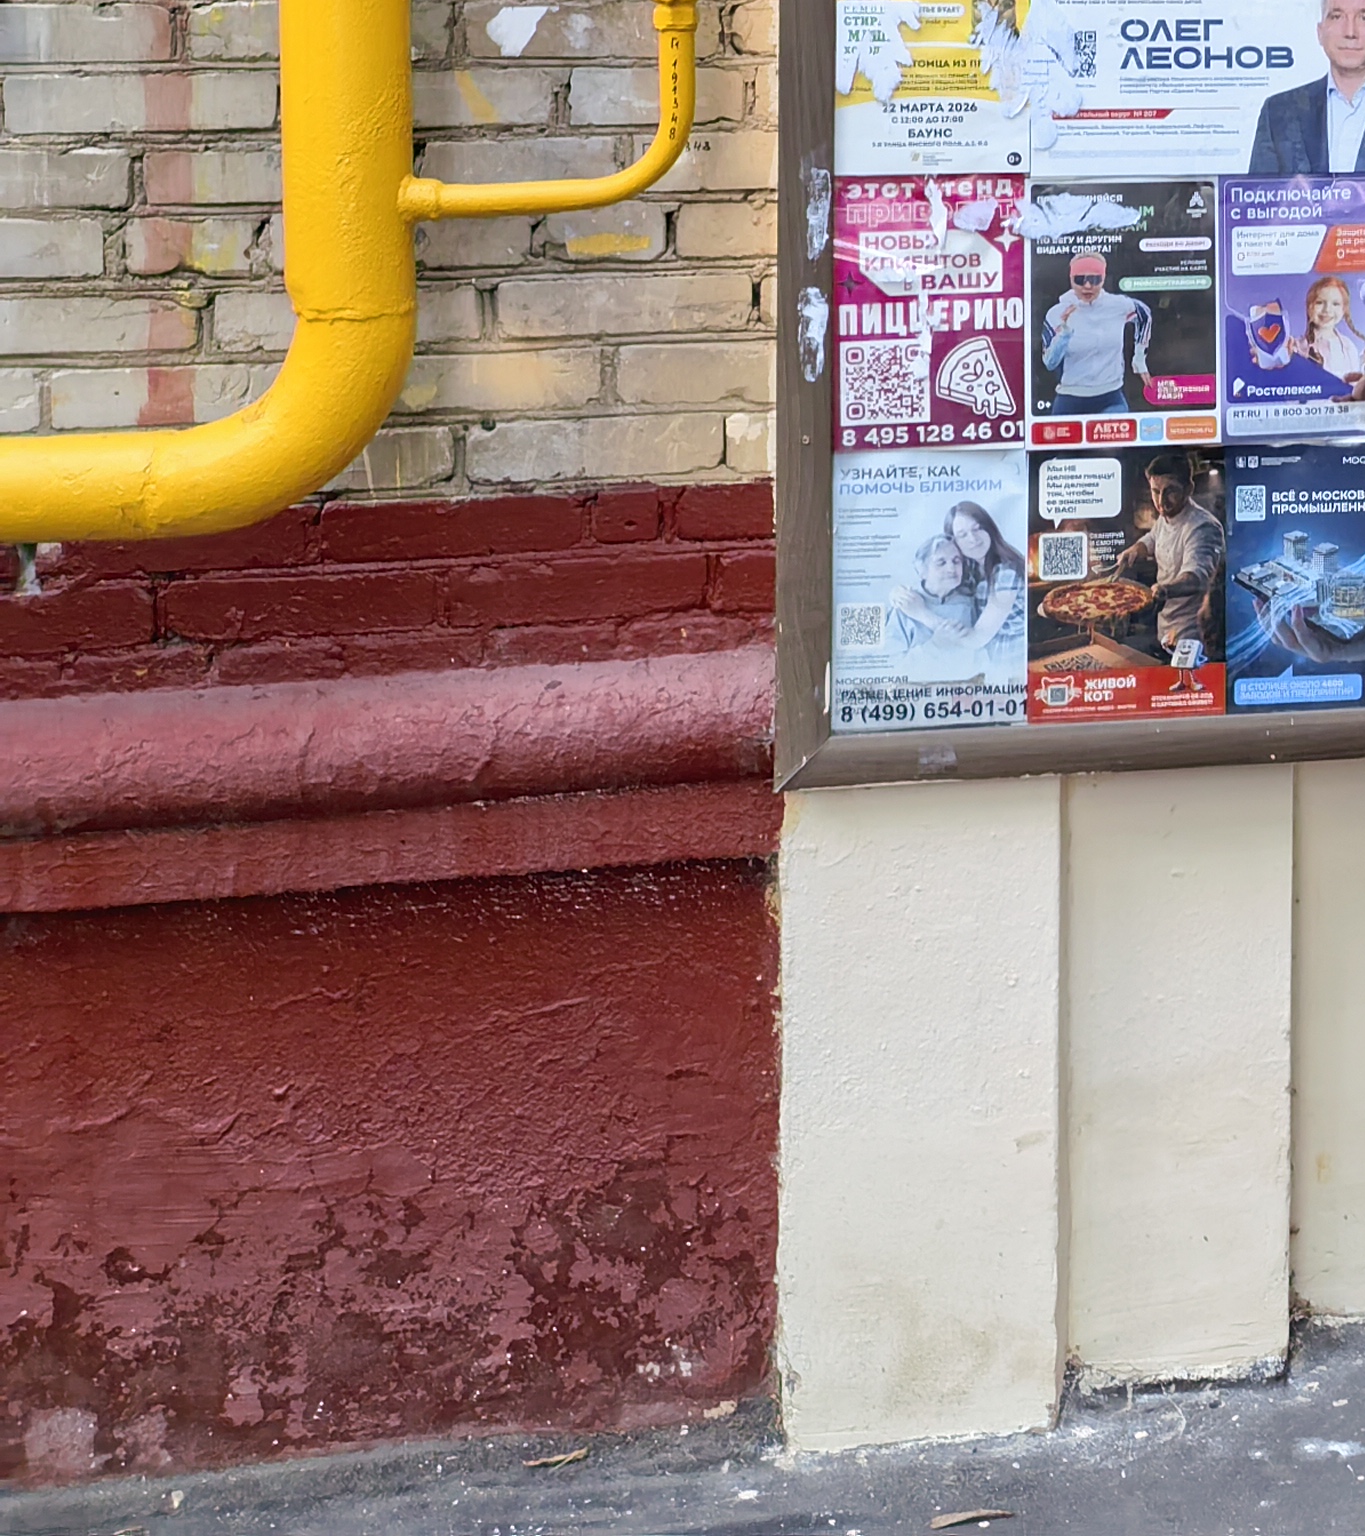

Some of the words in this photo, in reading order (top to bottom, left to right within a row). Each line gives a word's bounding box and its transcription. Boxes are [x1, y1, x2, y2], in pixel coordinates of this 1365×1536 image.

[1120, 19, 1223, 42] ОЛЕГ
[953, 60, 967, 68] ИЗ
[1120, 46, 1294, 70] ЛЕОНОВ
[900, 103, 944, 113] МАРТА
[948, 102, 977, 112] 2026
[926, 116, 938, 124] ДО
[908, 128, 952, 139] БАУНС
[847, 183, 915, 199] этот
[943, 179, 1013, 197] тенд
[1231, 186, 1351, 204] Подключайте
[1231, 208, 1241, 219] с
[1247, 203, 1322, 220] выгодой
[1085, 235, 1122, 244] ДРУГИМ
[1236, 231, 1277, 240] Интернет
[1297, 230, 1319, 238] дома
[1336, 238, 1351, 246] для
[1037, 246, 1069, 254] ВИДАМ
[1072, 245, 1111, 254] СПОРТА!
[922, 271, 998, 290] ВАШУ
[1247, 385, 1321, 397] Ростелеком
[1233, 410, 1261, 419] RT.RU
[1283, 408, 1302, 416] 800
[842, 429, 856, 446] 8
[864, 427, 908, 444] 495
[916, 424, 954, 442] 128
[962, 422, 992, 440] 46
[1000, 420, 1024, 438] 01
[1094, 422, 1129, 433] ЛЕТО
[840, 465, 922, 480] УЗНАЙТЕ,
[928, 465, 961, 477] КАК
[839, 482, 915, 495] ПОМОЧЬ
[920, 479, 1002, 493] БЛИЗКИМ
[1272, 489, 1296, 502] ВСЁ
[1299, 491, 1308, 501] О
[836, 675, 908, 685] МОСКОВСКАЯ
[1084, 674, 1137, 690] ЖИВОЙ
[1290, 681, 1320, 689] ОКОЛО
[936, 684, 1028, 698] ИНФОРМАЦИИ
[1084, 690, 1111, 702] КОТ
[841, 705, 852, 723] 8
[861, 703, 915, 724] (499)
[924, 699, 1027, 719] 654-01-01
